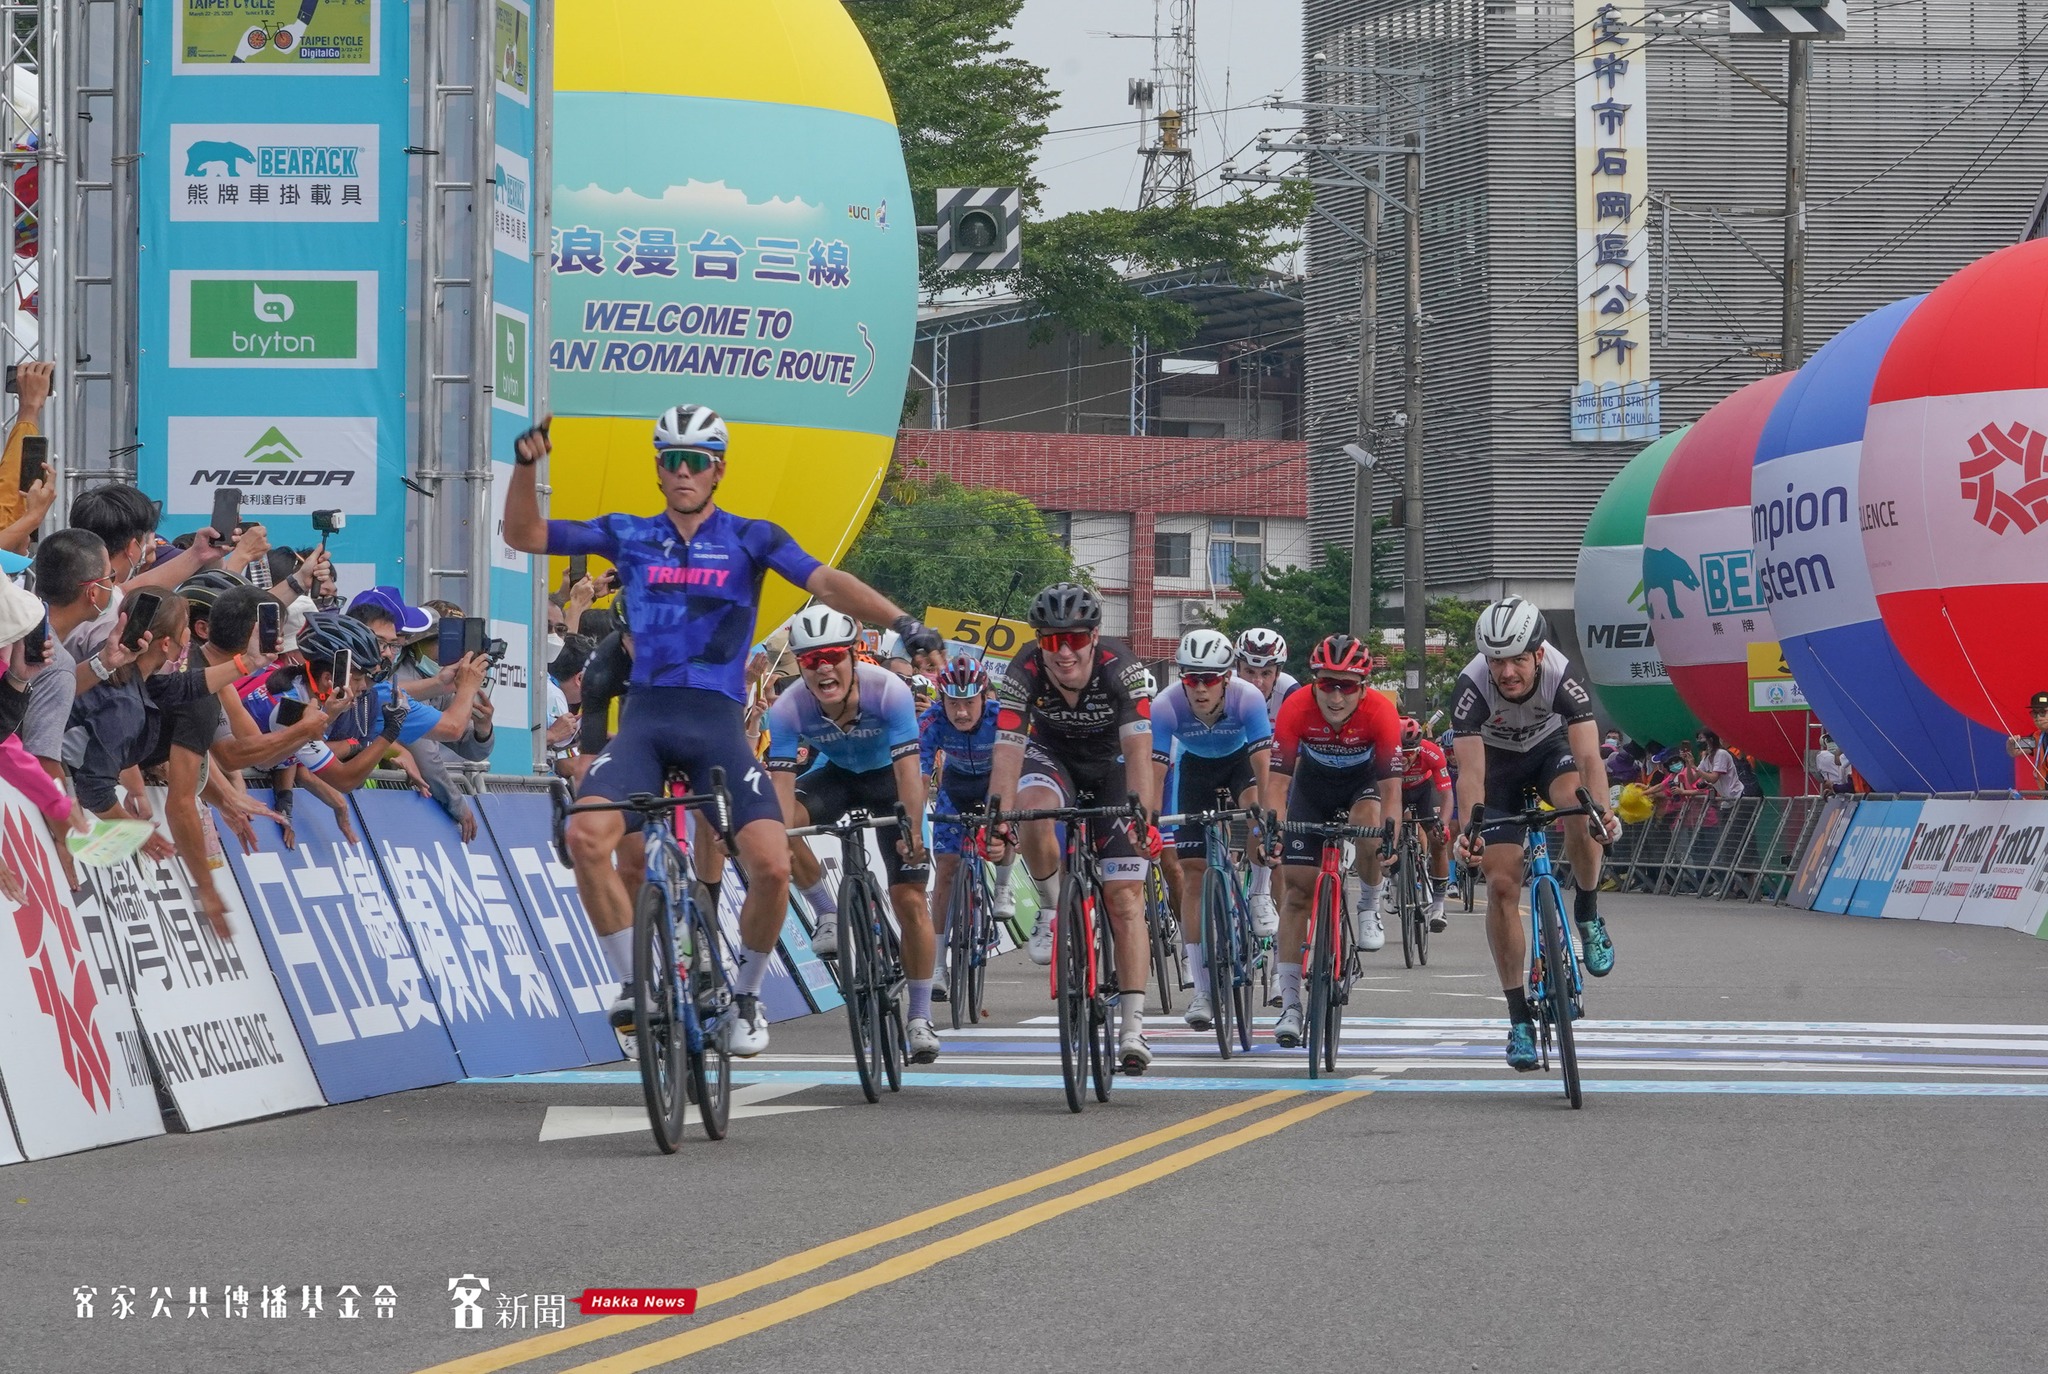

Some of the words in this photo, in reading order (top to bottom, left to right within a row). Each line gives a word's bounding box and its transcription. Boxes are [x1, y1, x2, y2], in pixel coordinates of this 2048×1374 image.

[189, 0, 229, 9] TAIPEI
[233, 0, 275, 9] CYCLE
[300, 36, 330, 46] TAIPEI
[333, 36, 363, 46] CYCLE
[301, 48, 340, 58] DigitalGo
[261, 149, 357, 175] BEARACK
[187, 184, 362, 205] 熊牌車掛載具
[853, 205, 870, 221] UCI
[550, 227, 850, 288] 浪漫台三線
[585, 302, 750, 336] WELCOME
[756, 309, 792, 339] TO
[232, 331, 315, 356] bryton
[602, 342, 771, 376] ROMANTIC
[775, 351, 855, 384] ROUTE
[190, 470, 355, 486] MERIDA
[240, 494, 306, 505] 美利達自行車
[1752, 483, 1847, 551] mpion
[1859, 501, 1898, 532] LLENCE
[648, 566, 730, 587] TRINITY
[1761, 553, 1835, 604] stem
[952, 619, 1016, 651] 50
[1516, 615, 1531, 642] RUDY
[1001, 732, 1025, 745] MJS
[1834, 826, 1911, 882] SHIMANO
[1118, 864, 1140, 872] MJS
[241, 840, 560, 1045] 日立變頻冷氣
[182, 1013, 285, 1078] EXCELLENCE
